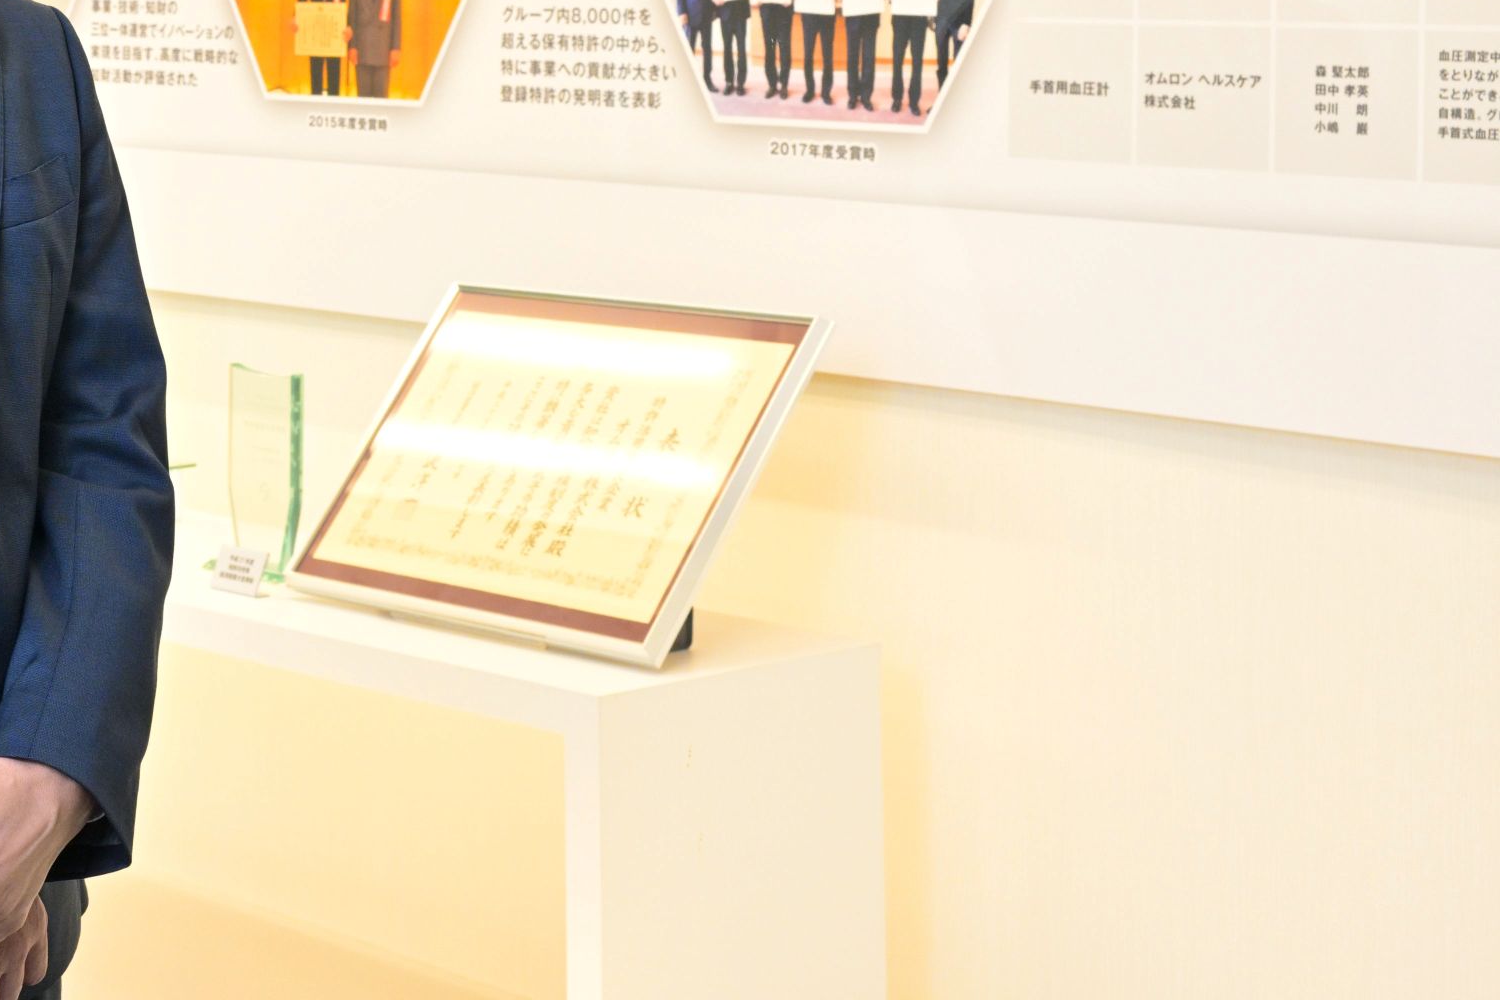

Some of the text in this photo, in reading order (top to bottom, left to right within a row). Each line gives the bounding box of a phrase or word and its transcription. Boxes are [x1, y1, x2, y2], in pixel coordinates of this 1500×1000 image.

[501, 59, 676, 81] 特に事業への貢献が大きい
[1029, 79, 1109, 97] 手首用血圧計
[1145, 72, 1262, 88] オムロン ヘルスケア
[501, 86, 661, 109] 登録特許の発明者を表彰
[1316, 84, 1339, 96] 田中
[1439, 89, 1500, 102] ことができ
[1144, 94, 1196, 110] 株式会社
[309, 116, 387, 131] 2015年度受賞時
[770, 141, 875, 161] 2017年度受賞時
